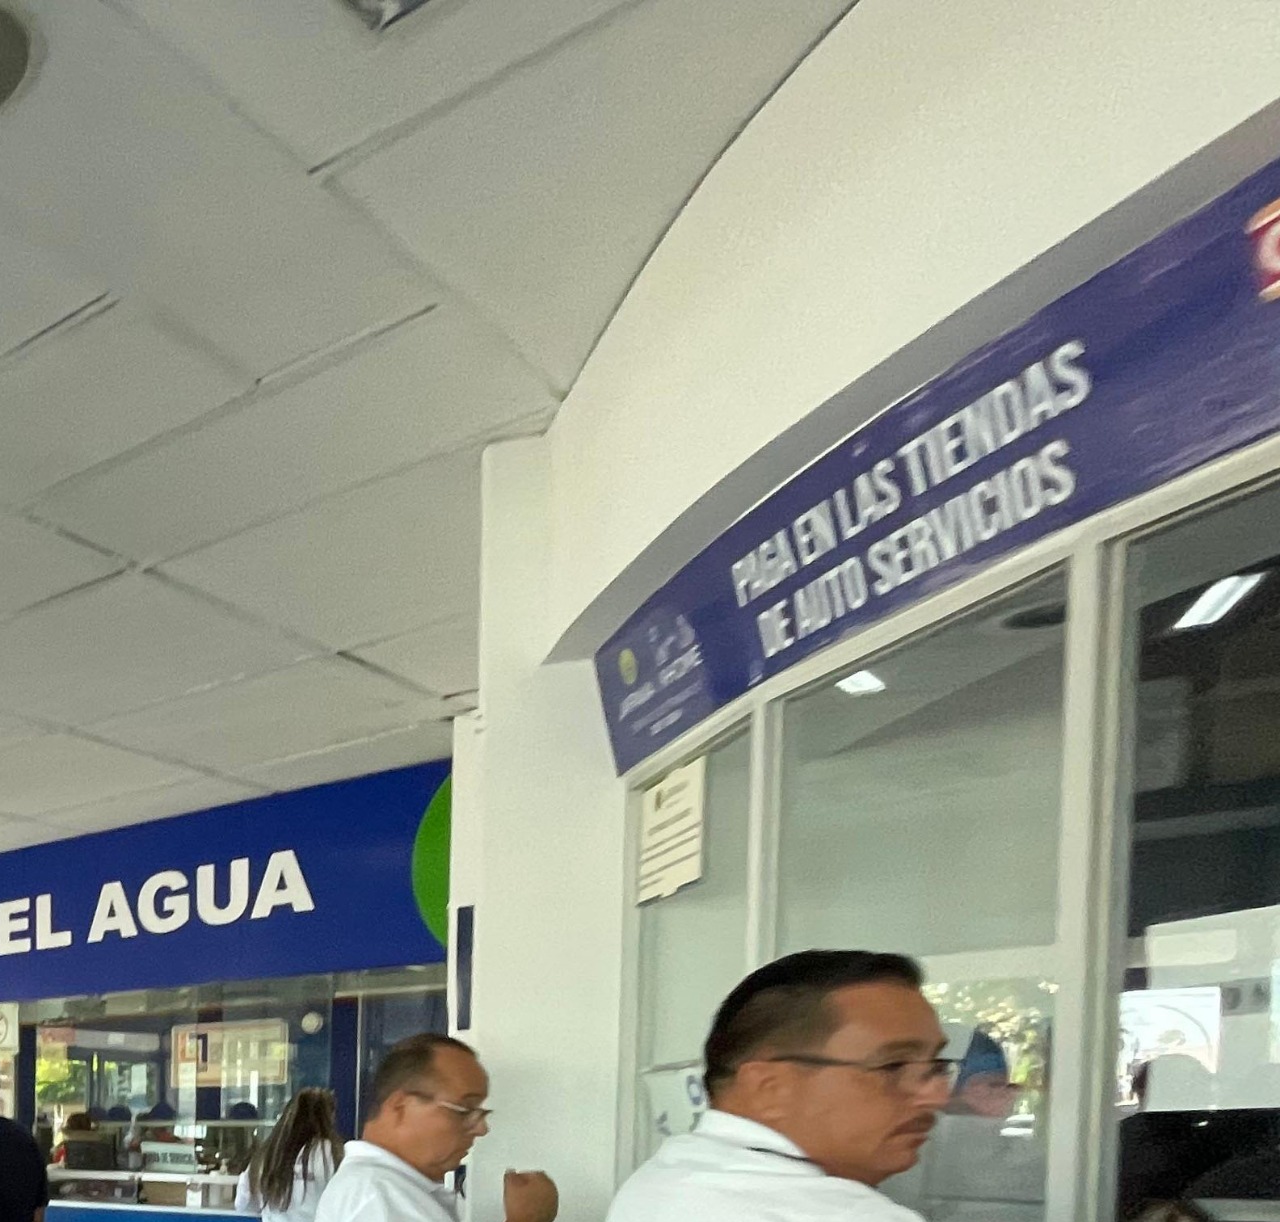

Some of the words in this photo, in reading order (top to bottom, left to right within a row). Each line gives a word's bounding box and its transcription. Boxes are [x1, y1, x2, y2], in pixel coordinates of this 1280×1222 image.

[731, 528, 798, 608] PAGA
[792, 498, 838, 567] EN
[832, 459, 902, 541] LAS
[897, 339, 1093, 497] TIENDAS
[756, 600, 796, 658] DE
[793, 556, 869, 640] AUTO
[867, 438, 1077, 596] SERVICIOS
[86, 849, 315, 944] AGUA
